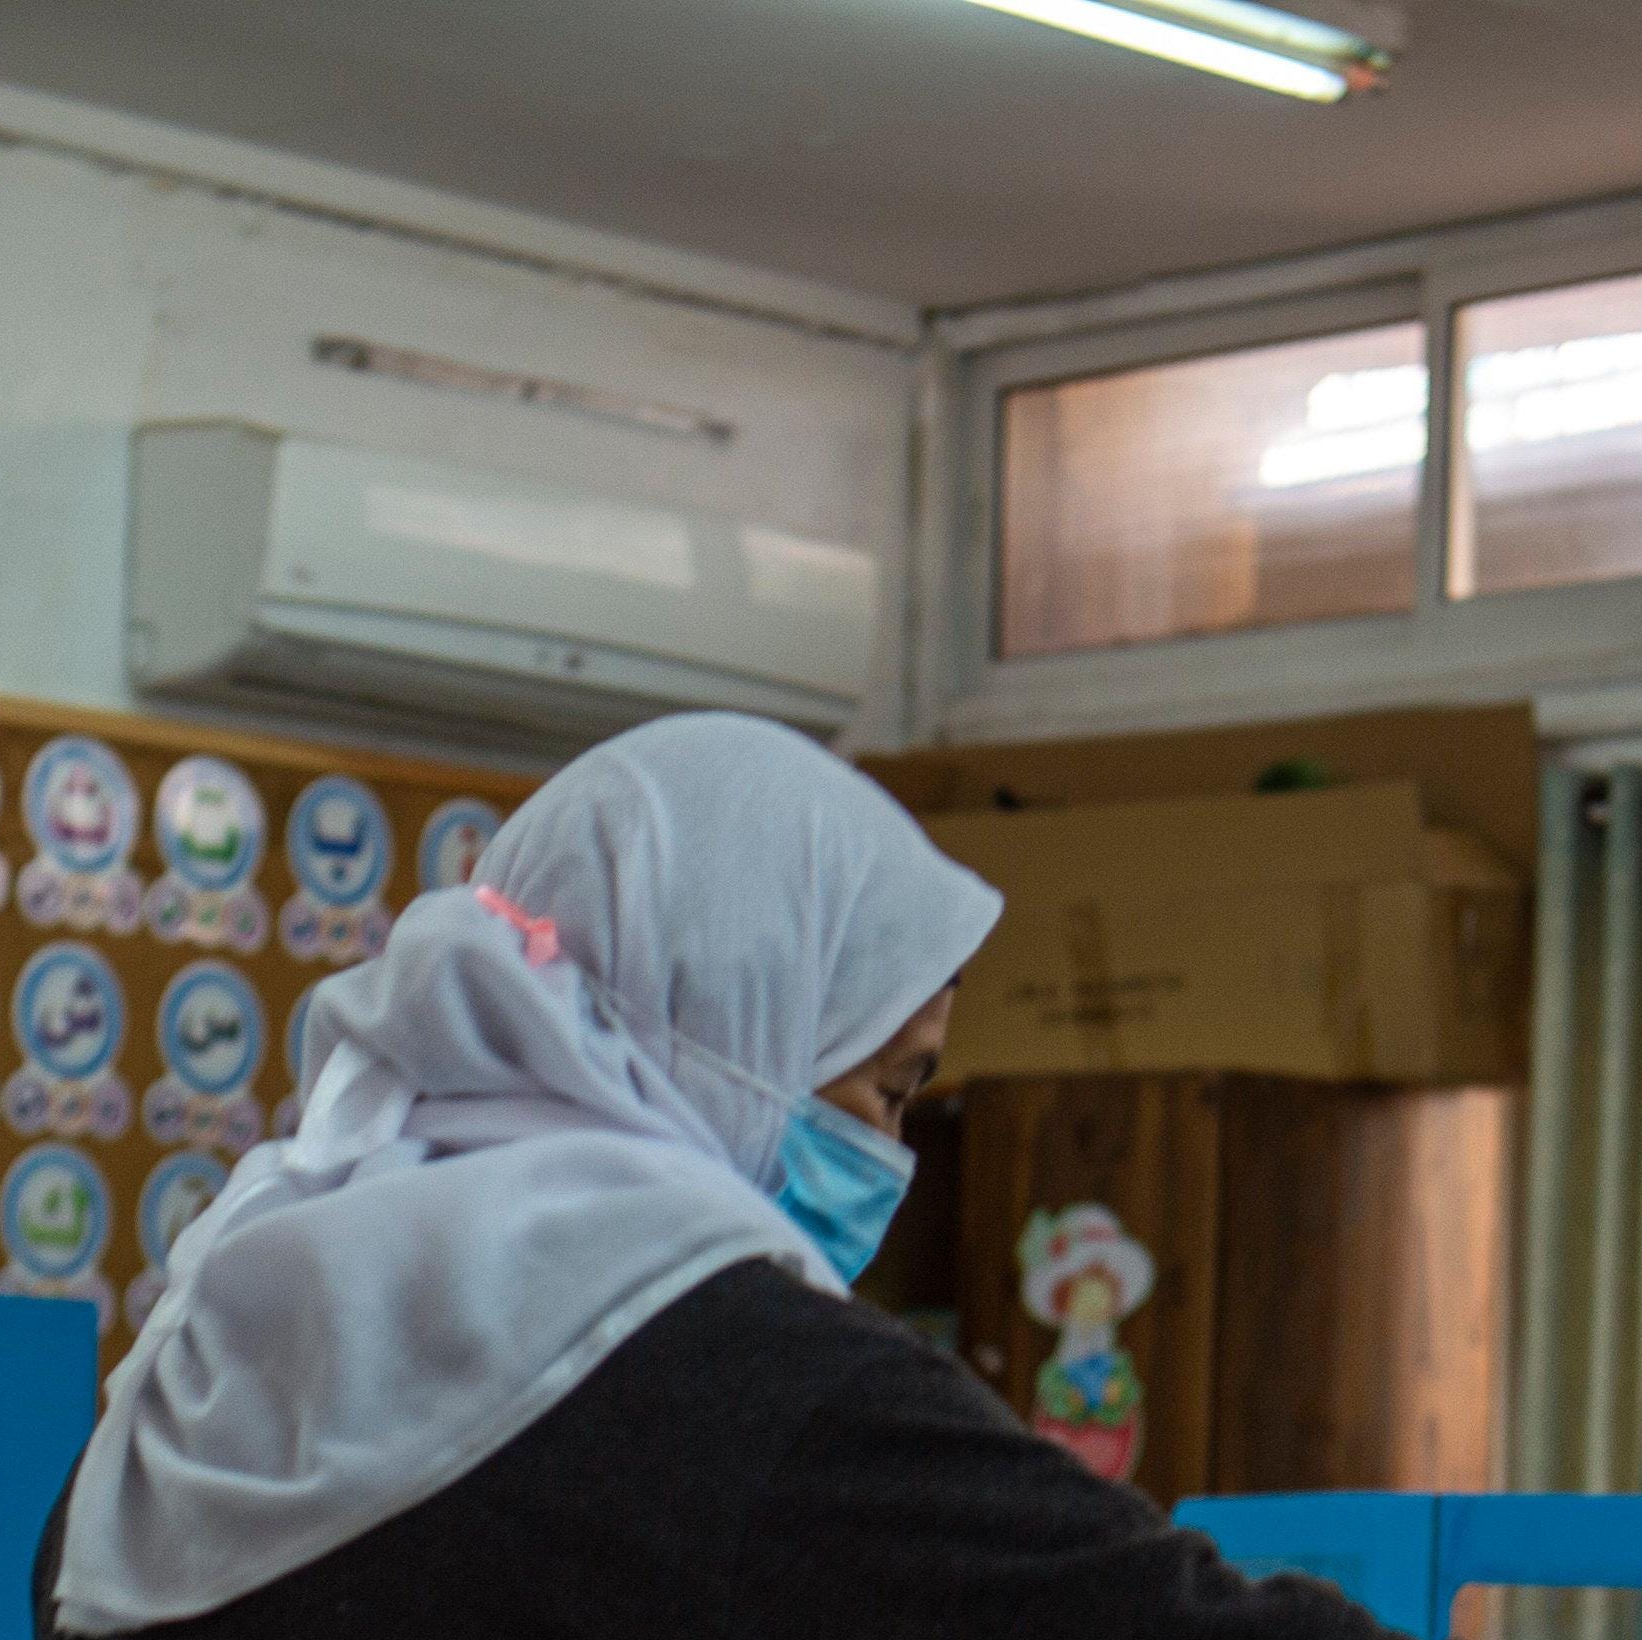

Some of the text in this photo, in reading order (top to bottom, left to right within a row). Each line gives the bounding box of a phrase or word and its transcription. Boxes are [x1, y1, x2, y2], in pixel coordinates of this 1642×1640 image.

[312, 818, 362, 884] ب
[38, 974, 102, 1047] ش
[181, 1006, 241, 1052] س
[21, 1177, 89, 1246] ك
